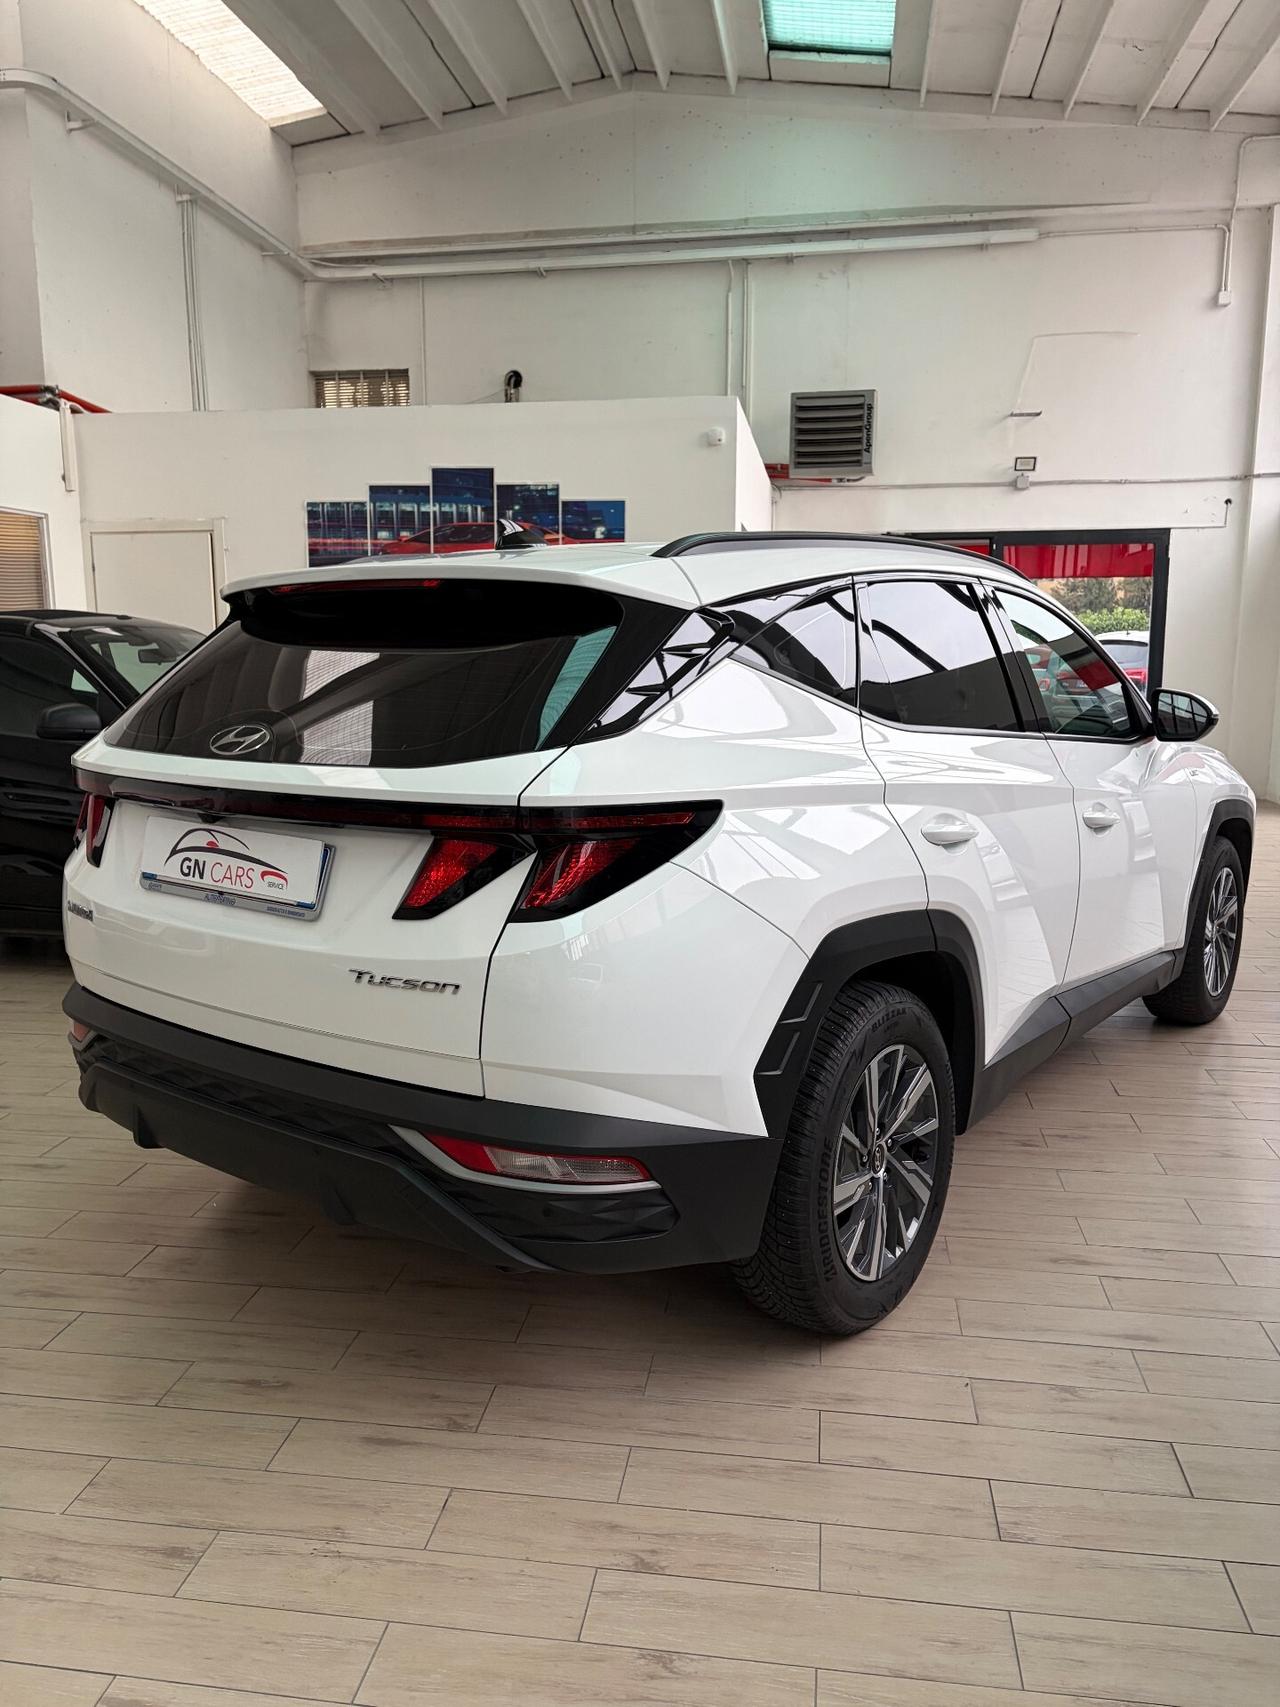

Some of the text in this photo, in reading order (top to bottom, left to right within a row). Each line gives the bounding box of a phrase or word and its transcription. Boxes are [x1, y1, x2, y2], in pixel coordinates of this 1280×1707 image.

[863, 402, 873, 454] ApenGroup
[180, 856, 255, 889] GN CARS
[817, 1135, 838, 1282] BRIDGESTONE
